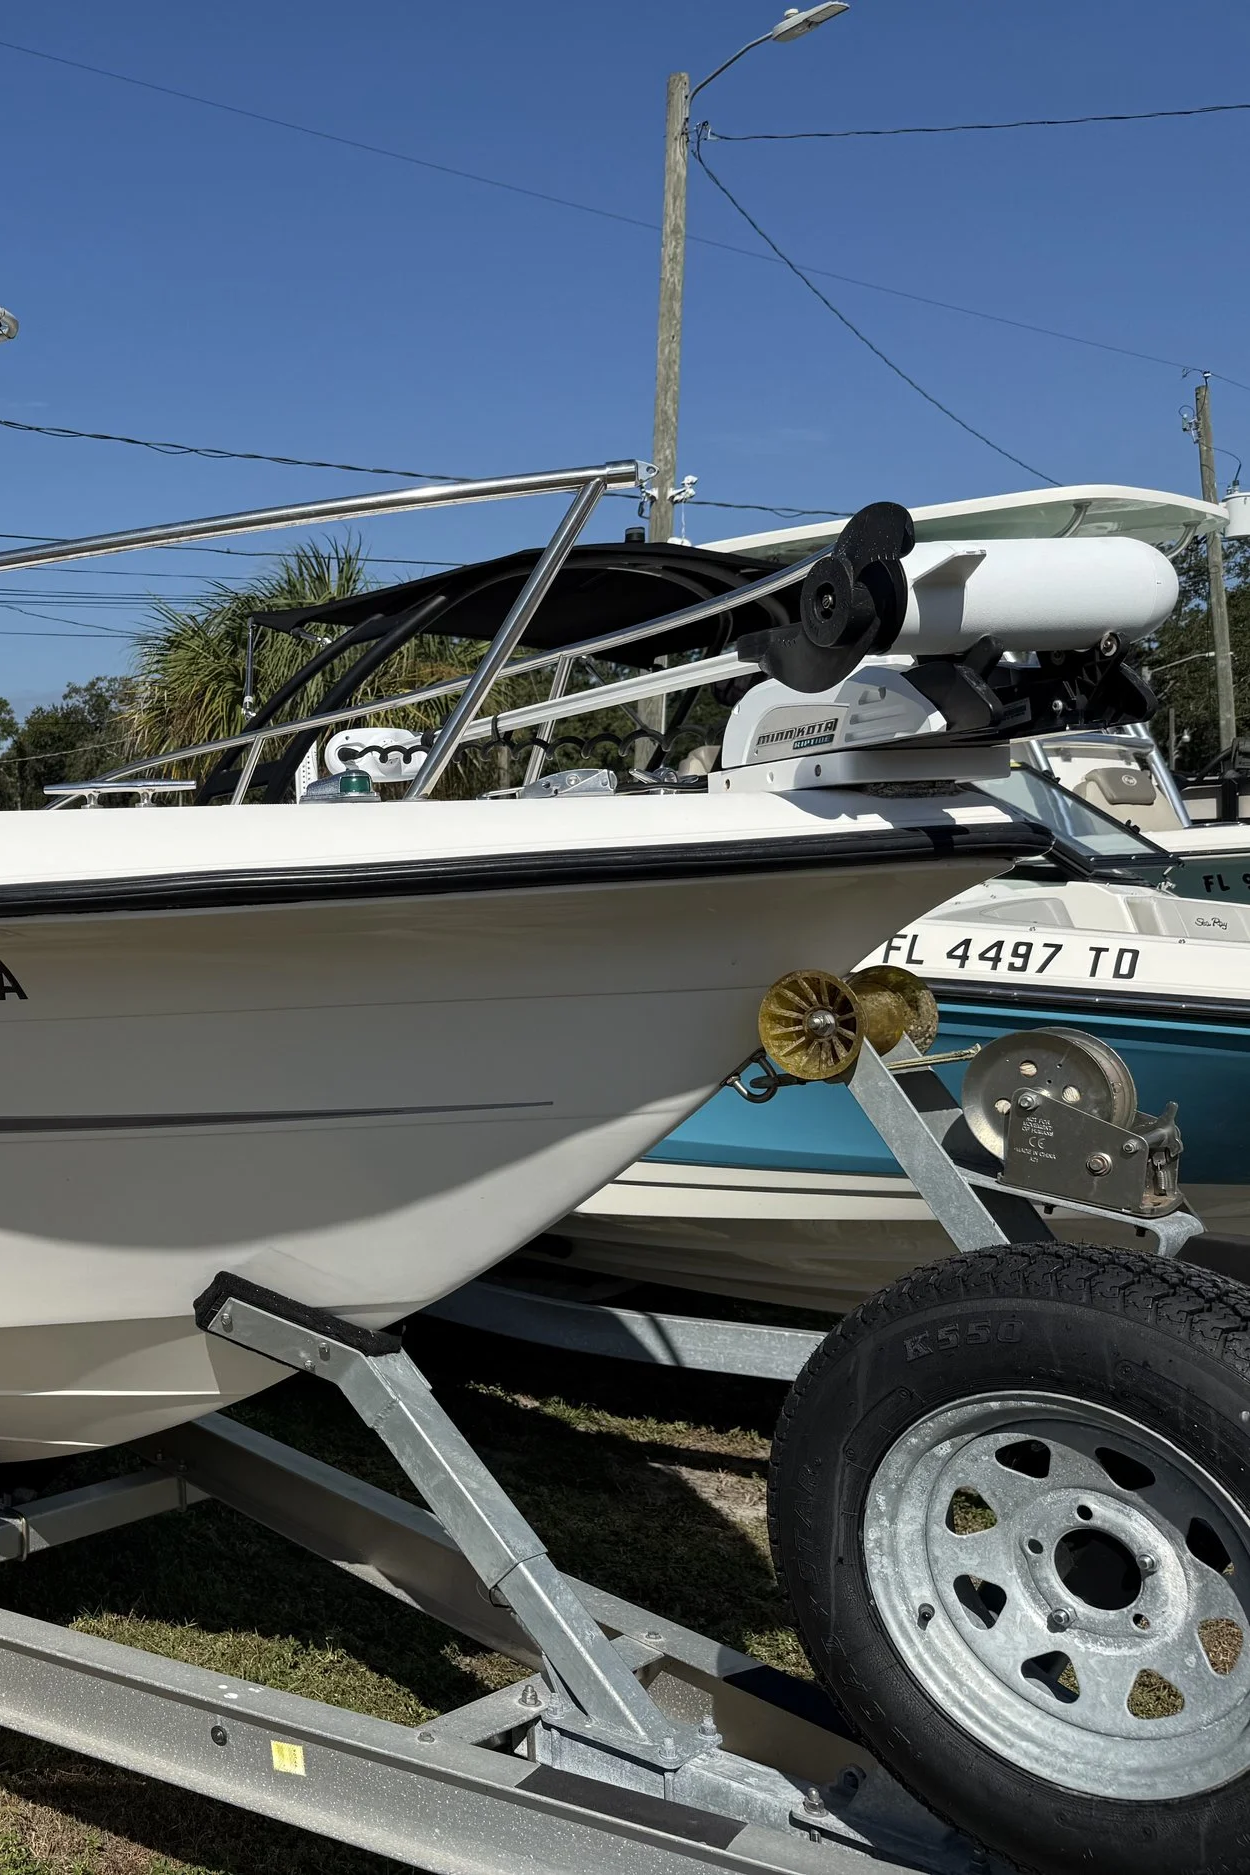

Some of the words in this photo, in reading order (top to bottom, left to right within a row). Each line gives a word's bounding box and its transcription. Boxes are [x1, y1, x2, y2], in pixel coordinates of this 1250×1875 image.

[795, 719, 837, 737] KOTA
[1202, 873, 1231, 894] FL
[1194, 917, 1212, 927] Sea
[1211, 917, 1228, 931] Ray
[882, 933, 924, 965] FL
[946, 938, 1063, 973] 4497
[1089, 946, 1140, 979] TD
[903, 1318, 1024, 1363] K550
